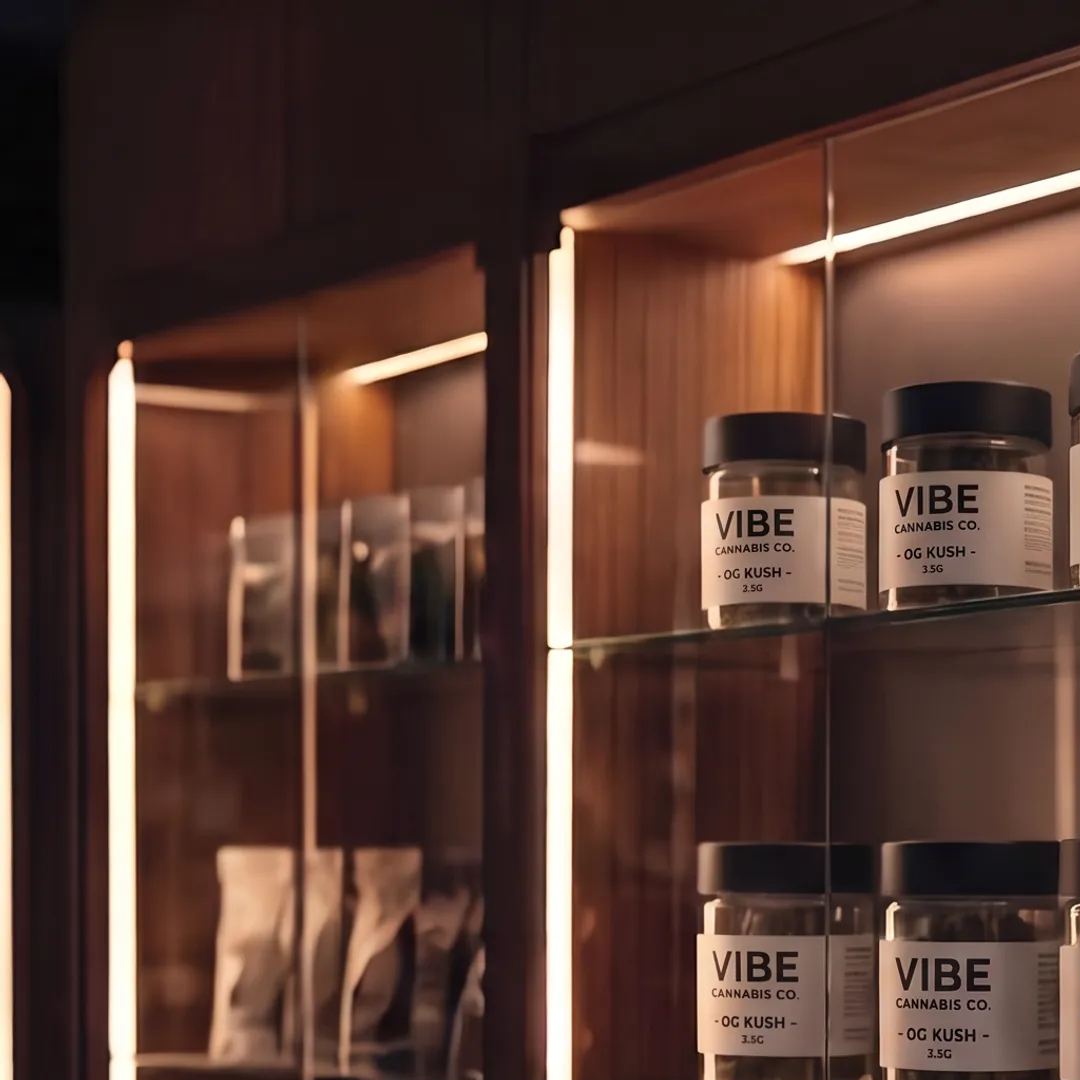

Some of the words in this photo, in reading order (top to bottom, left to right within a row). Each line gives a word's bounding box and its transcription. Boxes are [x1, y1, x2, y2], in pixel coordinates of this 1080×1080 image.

[895, 484, 979, 518] VIBE
[716, 508, 794, 540] VIBE
[894, 520, 954, 534] CANNABIS
[957, 520, 980, 531] CO.
[715, 542, 770, 556] CANNABIS
[773, 542, 795, 553] CO.
[904, 547, 922, 560] OG
[926, 545, 966, 559] KUSH
[724, 568, 740, 580] OG
[744, 566, 782, 579] KUSH
[922, 564, 944, 574] 3.5G
[742, 584, 763, 593] 3.5G
[712, 950, 799, 983] VIBE
[895, 957, 991, 992] VIBE
[711, 988, 772, 1000] CANNABIS
[776, 989, 800, 1000] CO.
[896, 997, 962, 1011] CANNABIS
[966, 999, 991, 1011] CO.
[721, 1015, 740, 1028] OG
[744, 1016, 785, 1029] KUSH
[741, 1035, 764, 1044] 3.5G
[906, 1027, 927, 1041] OG
[932, 1027, 976, 1042] KUSH
[927, 1048, 952, 1059] 3.5G
